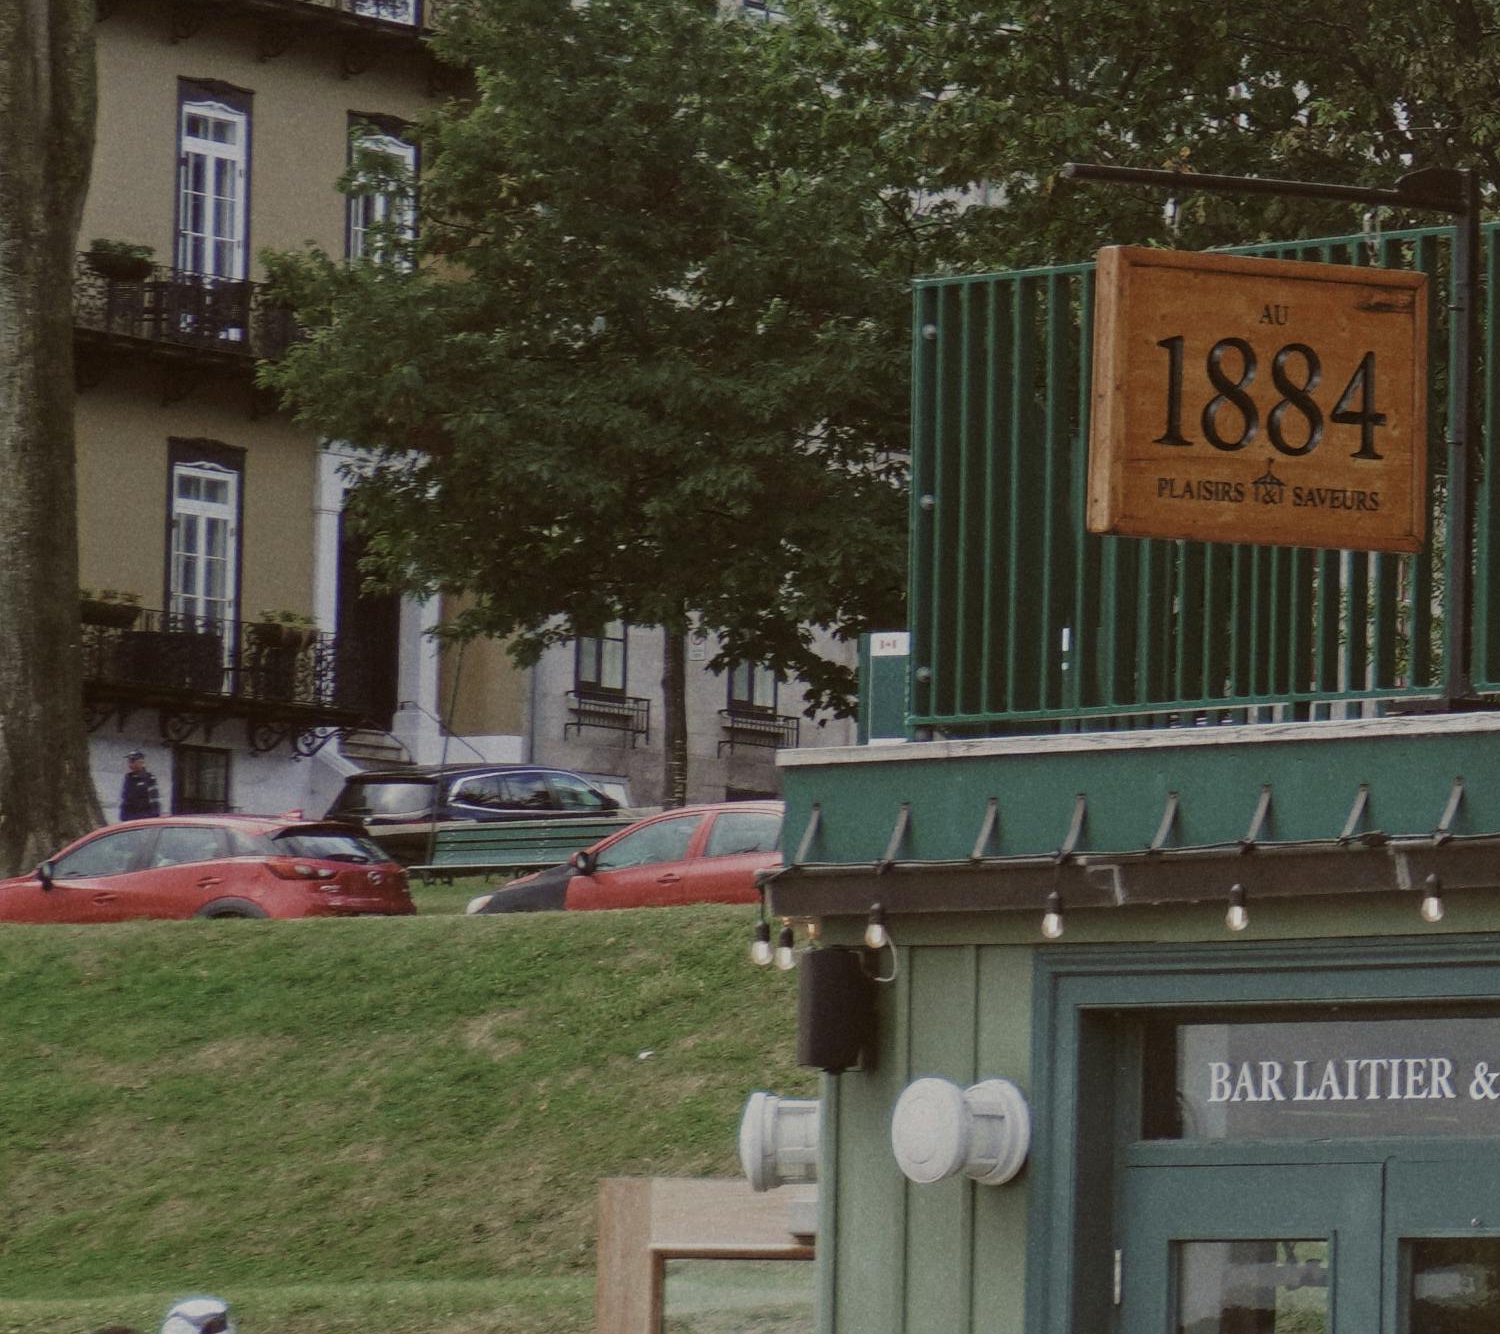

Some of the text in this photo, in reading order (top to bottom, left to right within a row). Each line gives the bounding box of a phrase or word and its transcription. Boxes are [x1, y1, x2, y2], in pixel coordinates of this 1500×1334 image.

[1259, 303, 1289, 326] AU
[1151, 334, 1388, 461] 1884
[1156, 477, 1246, 503] PLAISIRS
[1291, 486, 1380, 512] SAVEURS
[1207, 1060, 1291, 1104] BAR
[1292, 1056, 1456, 1102] LAITIER
[1467, 1061, 1500, 1101] &
